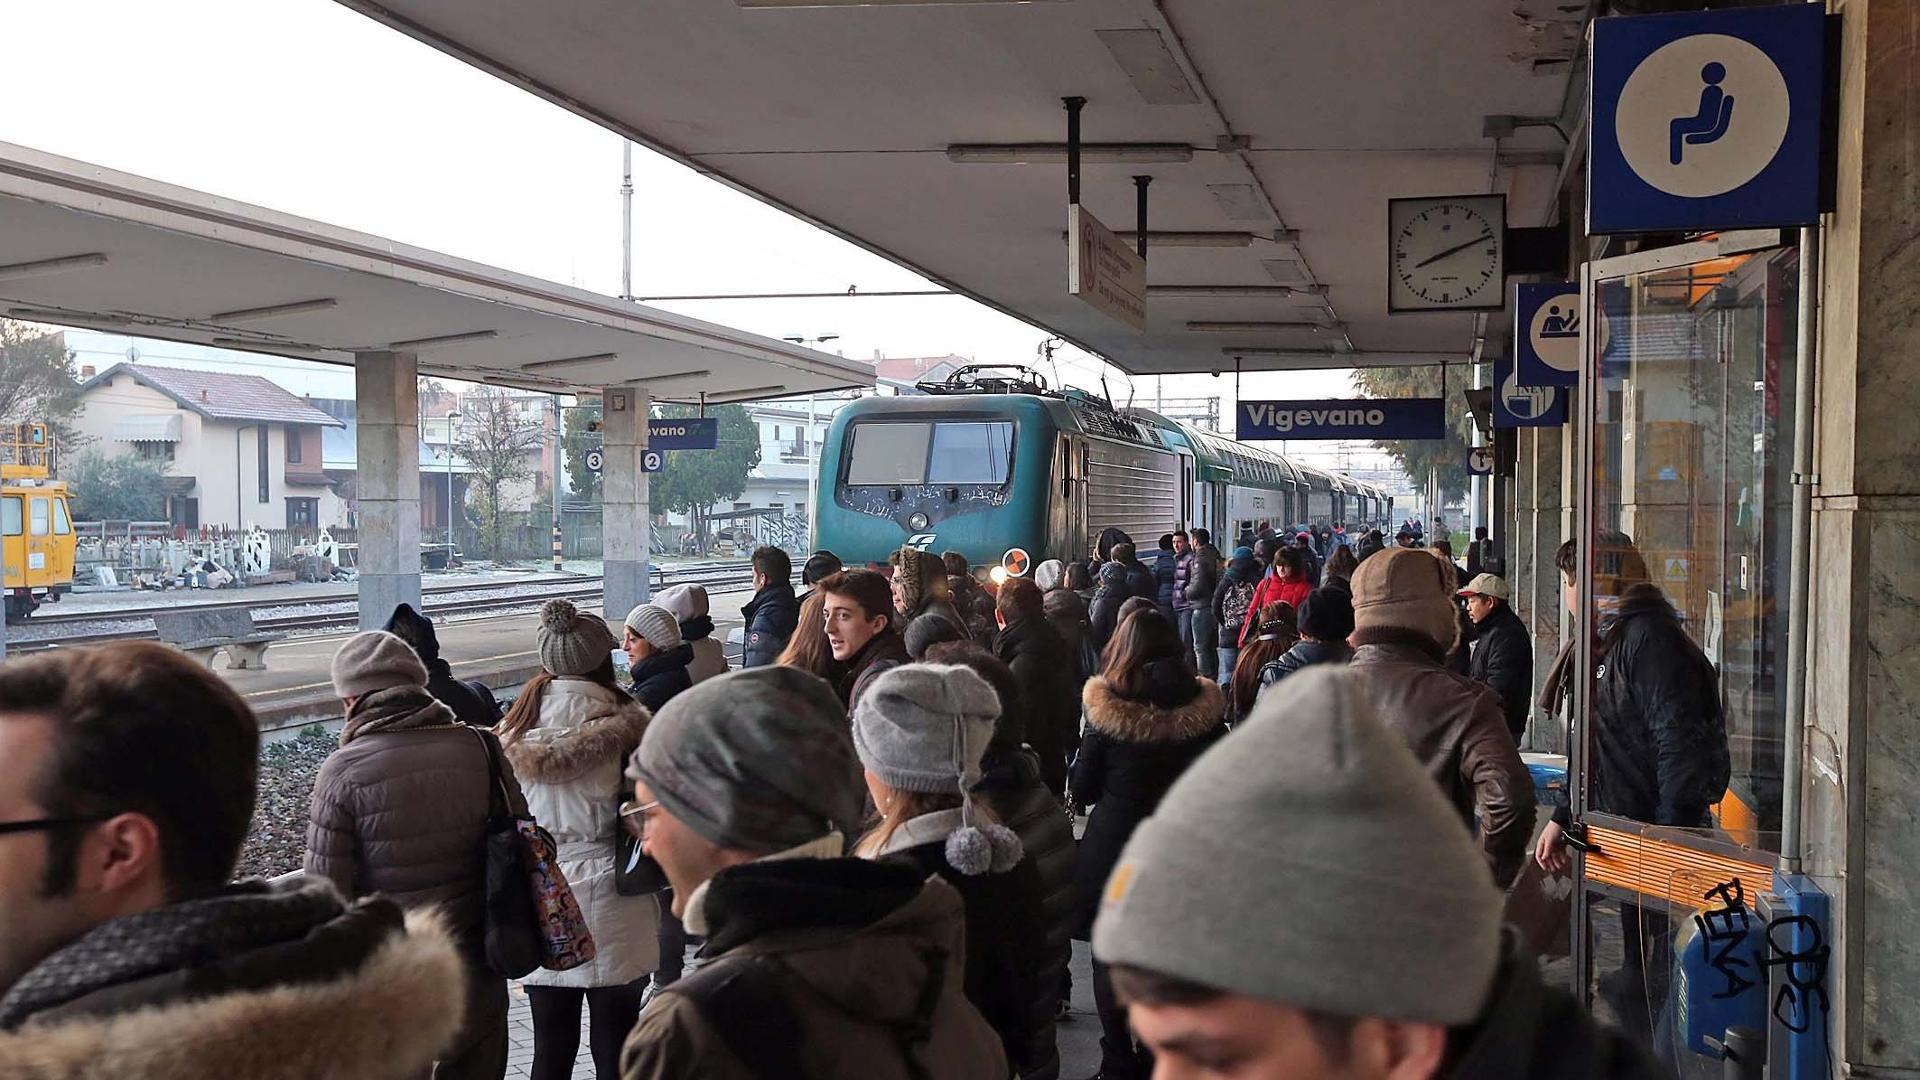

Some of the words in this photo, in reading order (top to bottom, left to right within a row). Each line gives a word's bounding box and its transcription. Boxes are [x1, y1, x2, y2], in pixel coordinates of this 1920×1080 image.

[1246, 404, 1385, 432] Vigevano
[648, 427, 686, 436] vano
[590, 455, 599, 467] 3
[648, 455, 657, 467] 2
